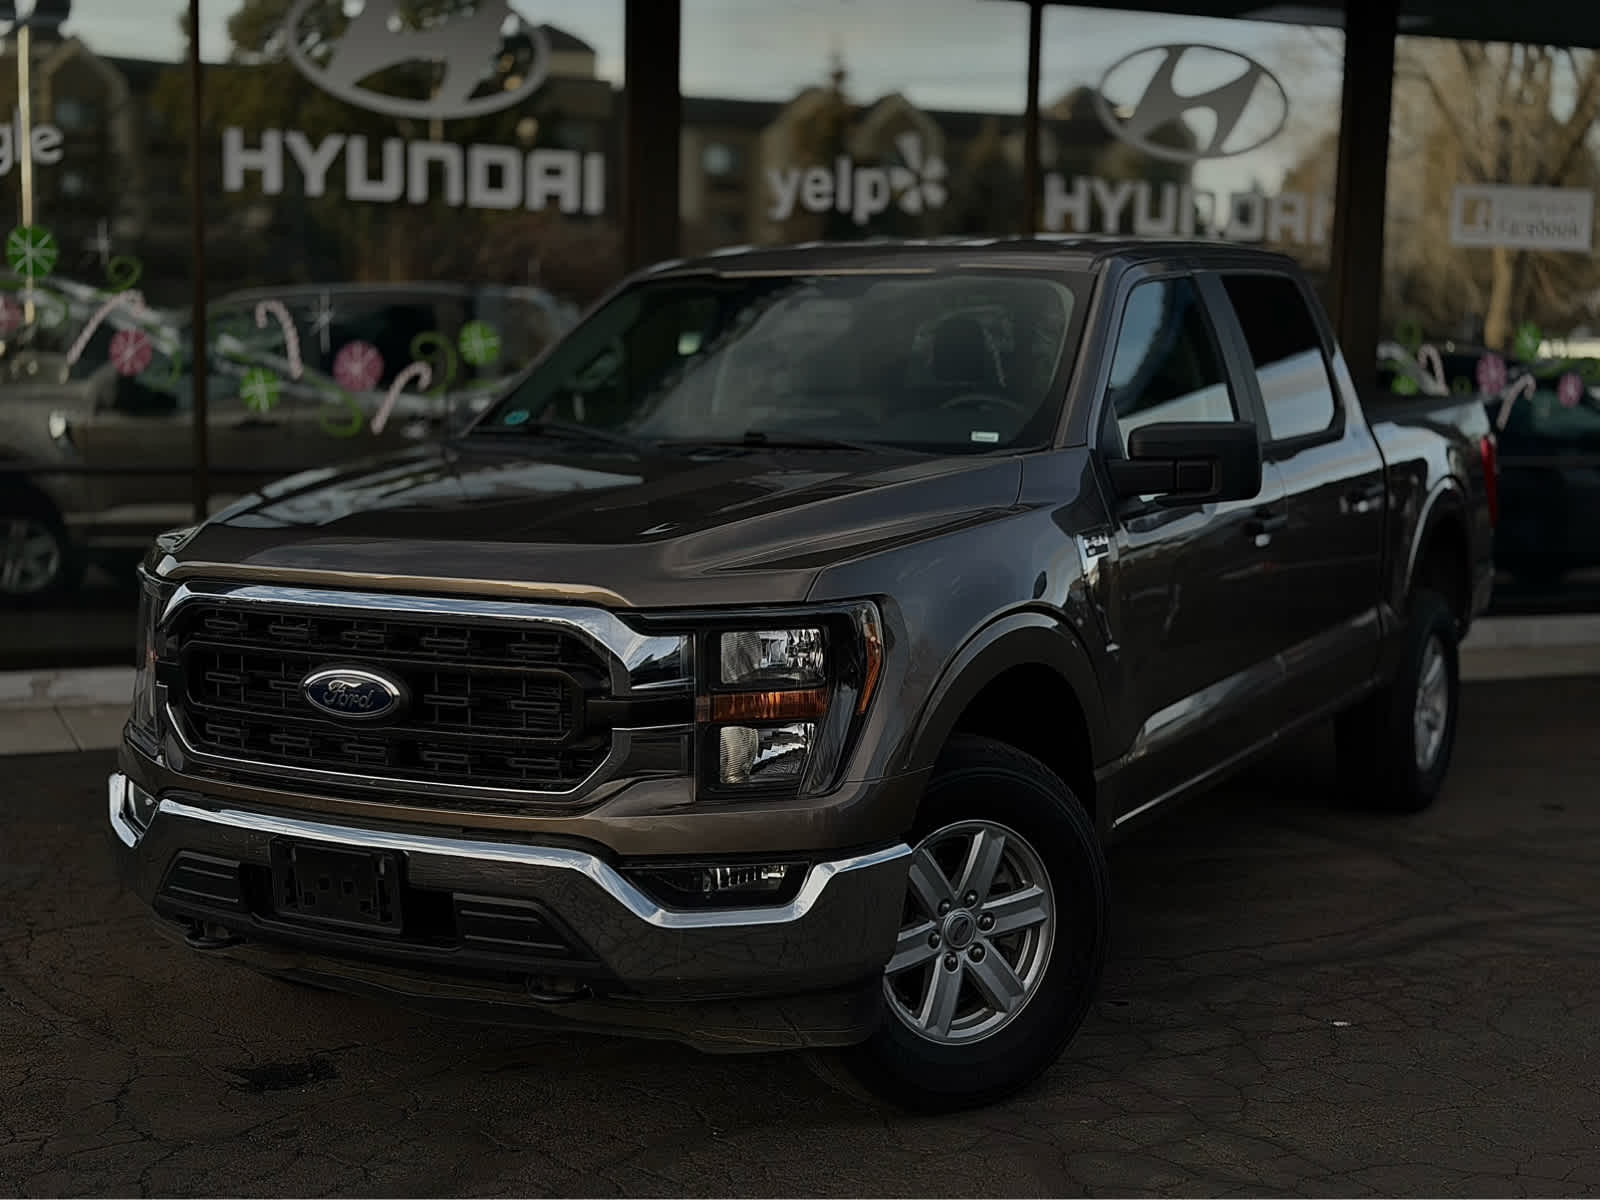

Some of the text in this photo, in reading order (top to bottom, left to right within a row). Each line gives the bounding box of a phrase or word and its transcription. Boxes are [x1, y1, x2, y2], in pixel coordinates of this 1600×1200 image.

[222, 126, 606, 216] HYUNDAI
[768, 154, 891, 225] yelp
[322, 679, 376, 711] Ford
